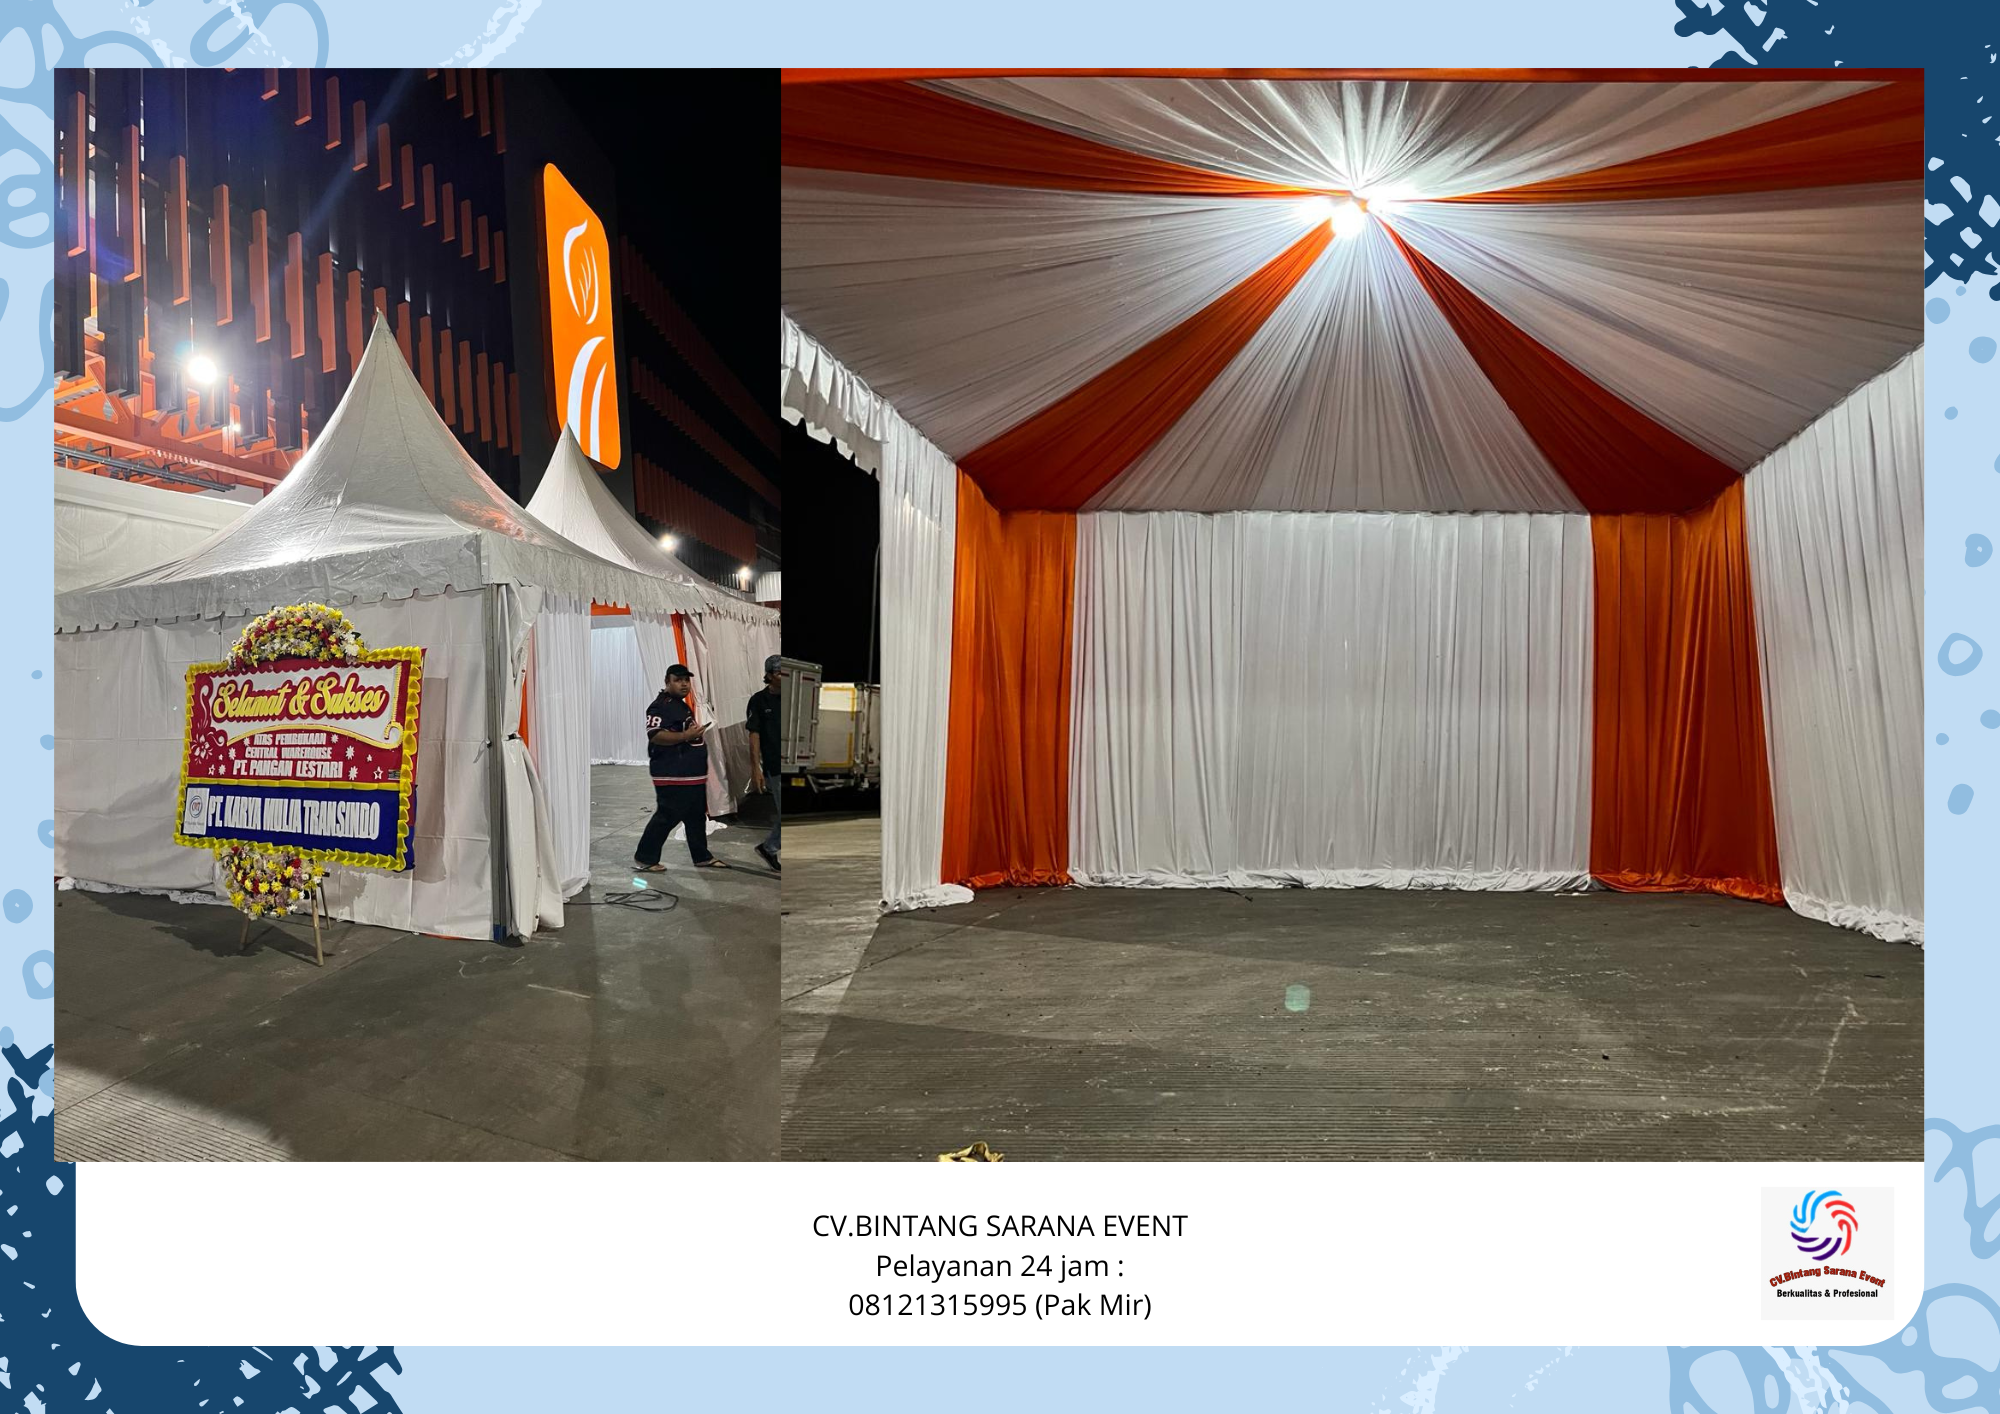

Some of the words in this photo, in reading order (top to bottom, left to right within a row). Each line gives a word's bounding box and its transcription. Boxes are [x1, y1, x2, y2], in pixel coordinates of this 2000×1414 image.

[212, 683, 292, 719] Selamat
[289, 680, 311, 716] &
[310, 676, 386, 716] Sukses
[244, 746, 278, 759] CENTRAL
[281, 746, 333, 759] WAREHOUSE
[249, 760, 294, 777] PANGAN
[295, 760, 344, 779] LESTARI
[223, 795, 262, 831] KARYA
[263, 797, 302, 834] MULIA
[302, 800, 381, 840] TRANSINDO
